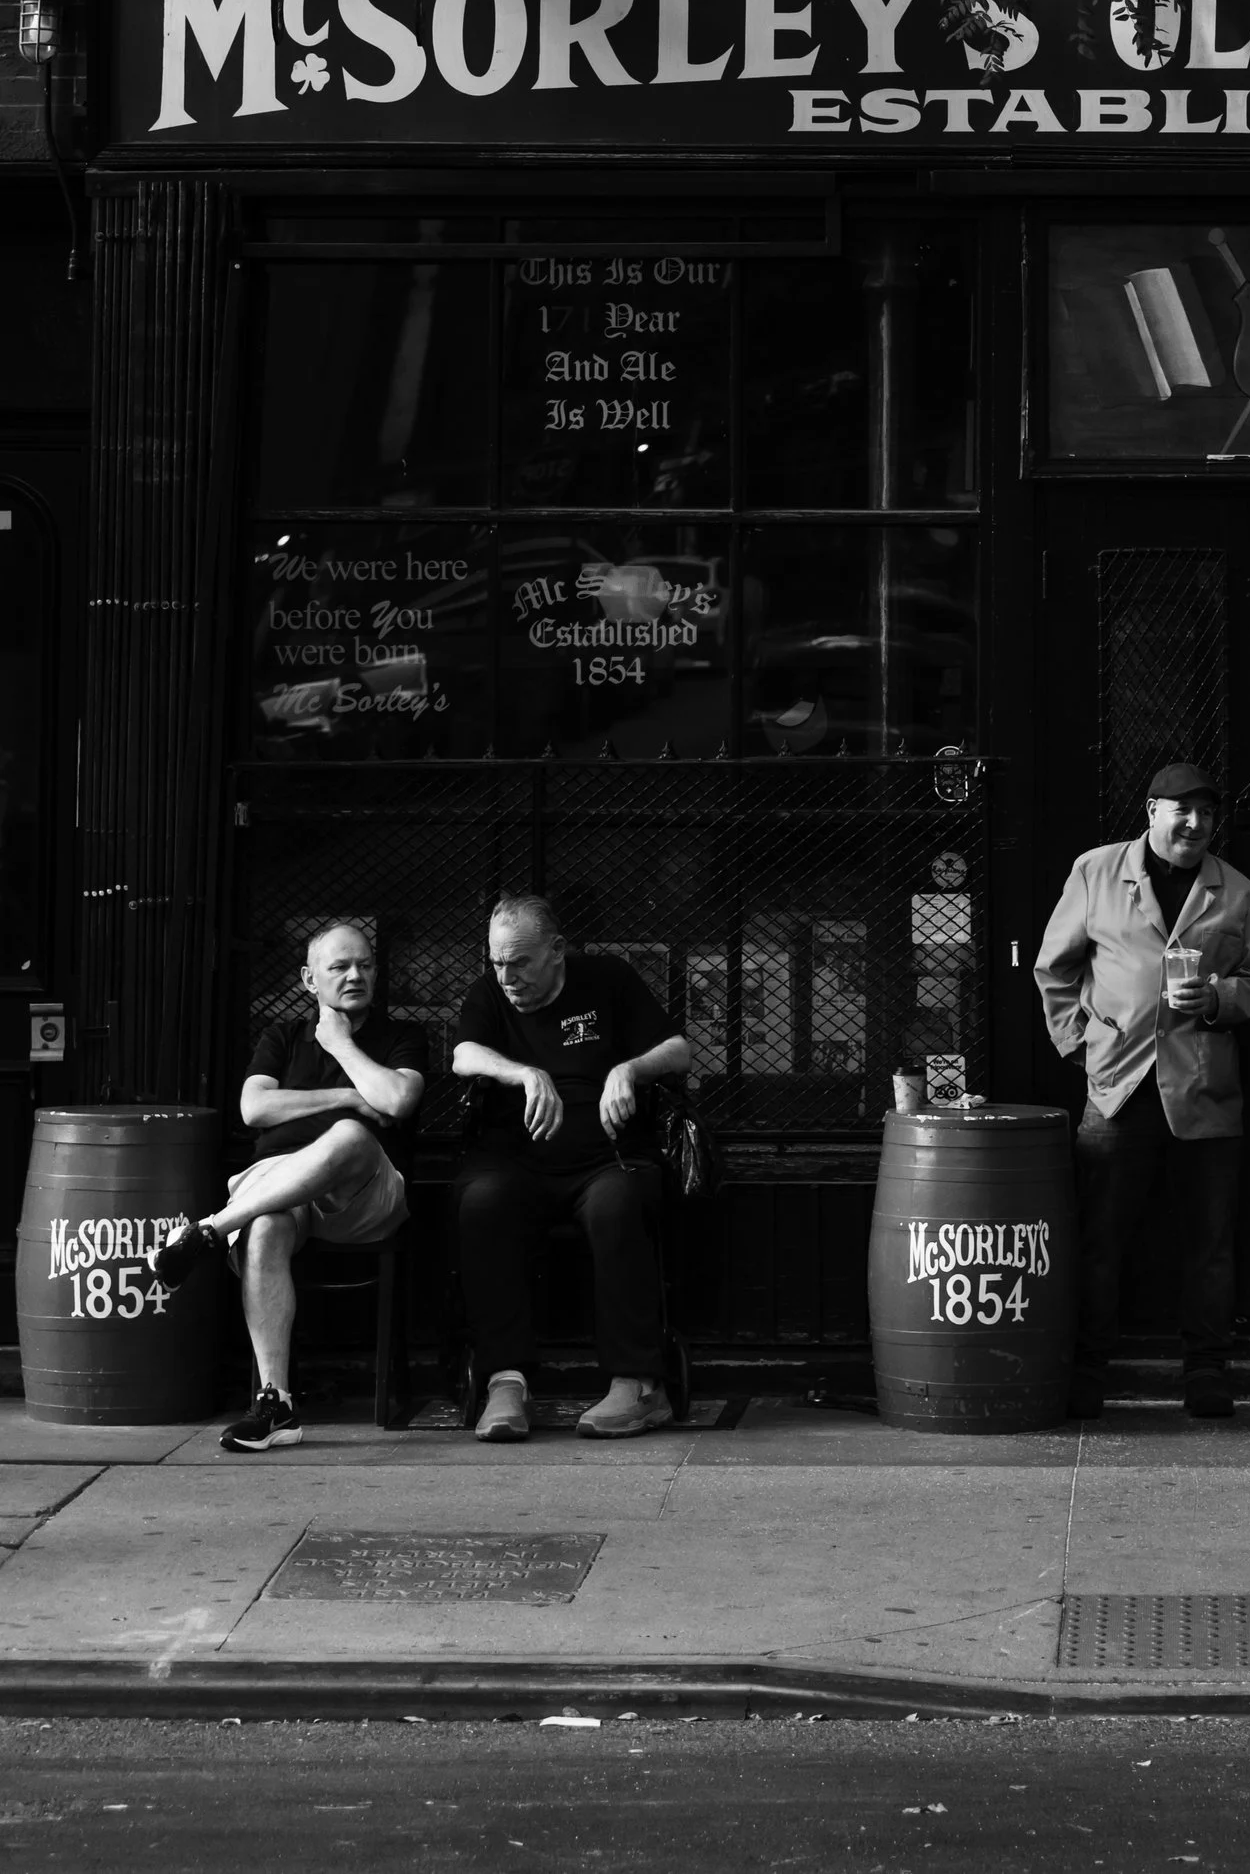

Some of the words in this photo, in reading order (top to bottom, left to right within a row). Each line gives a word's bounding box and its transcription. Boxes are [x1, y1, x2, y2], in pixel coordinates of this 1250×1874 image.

[519, 257, 592, 291] This
[602, 258, 644, 285] Is
[653, 257, 721, 285] Our
[603, 302, 681, 338] Year
[544, 351, 609, 382] And
[620, 351, 679, 382] Ale
[544, 399, 585, 430] Is
[596, 399, 671, 430] Well
[269, 553, 318, 581] We
[327, 558, 397, 581] were
[405, 551, 469, 581] here
[511, 577, 568, 622] Mc
[269, 600, 361, 630] before
[370, 600, 435, 640] You
[529, 618, 698, 653] Established
[274, 644, 346, 666] were
[572, 656, 646, 686] 1854
[273, 683, 322, 714] Mc
[332, 682, 451, 722] Sorley's
[907, 1219, 1050, 1283] McSORLEY'S
[70, 1266, 170, 1319] 1854
[929, 1273, 1029, 1325] 1854
[351, 1550, 474, 1558] ORDER
[334, 1569, 412, 1577] OUR
[340, 1579, 388, 1588] US
[413, 1580, 511, 1589] HELP
[346, 1589, 489, 1599] PLEASE
